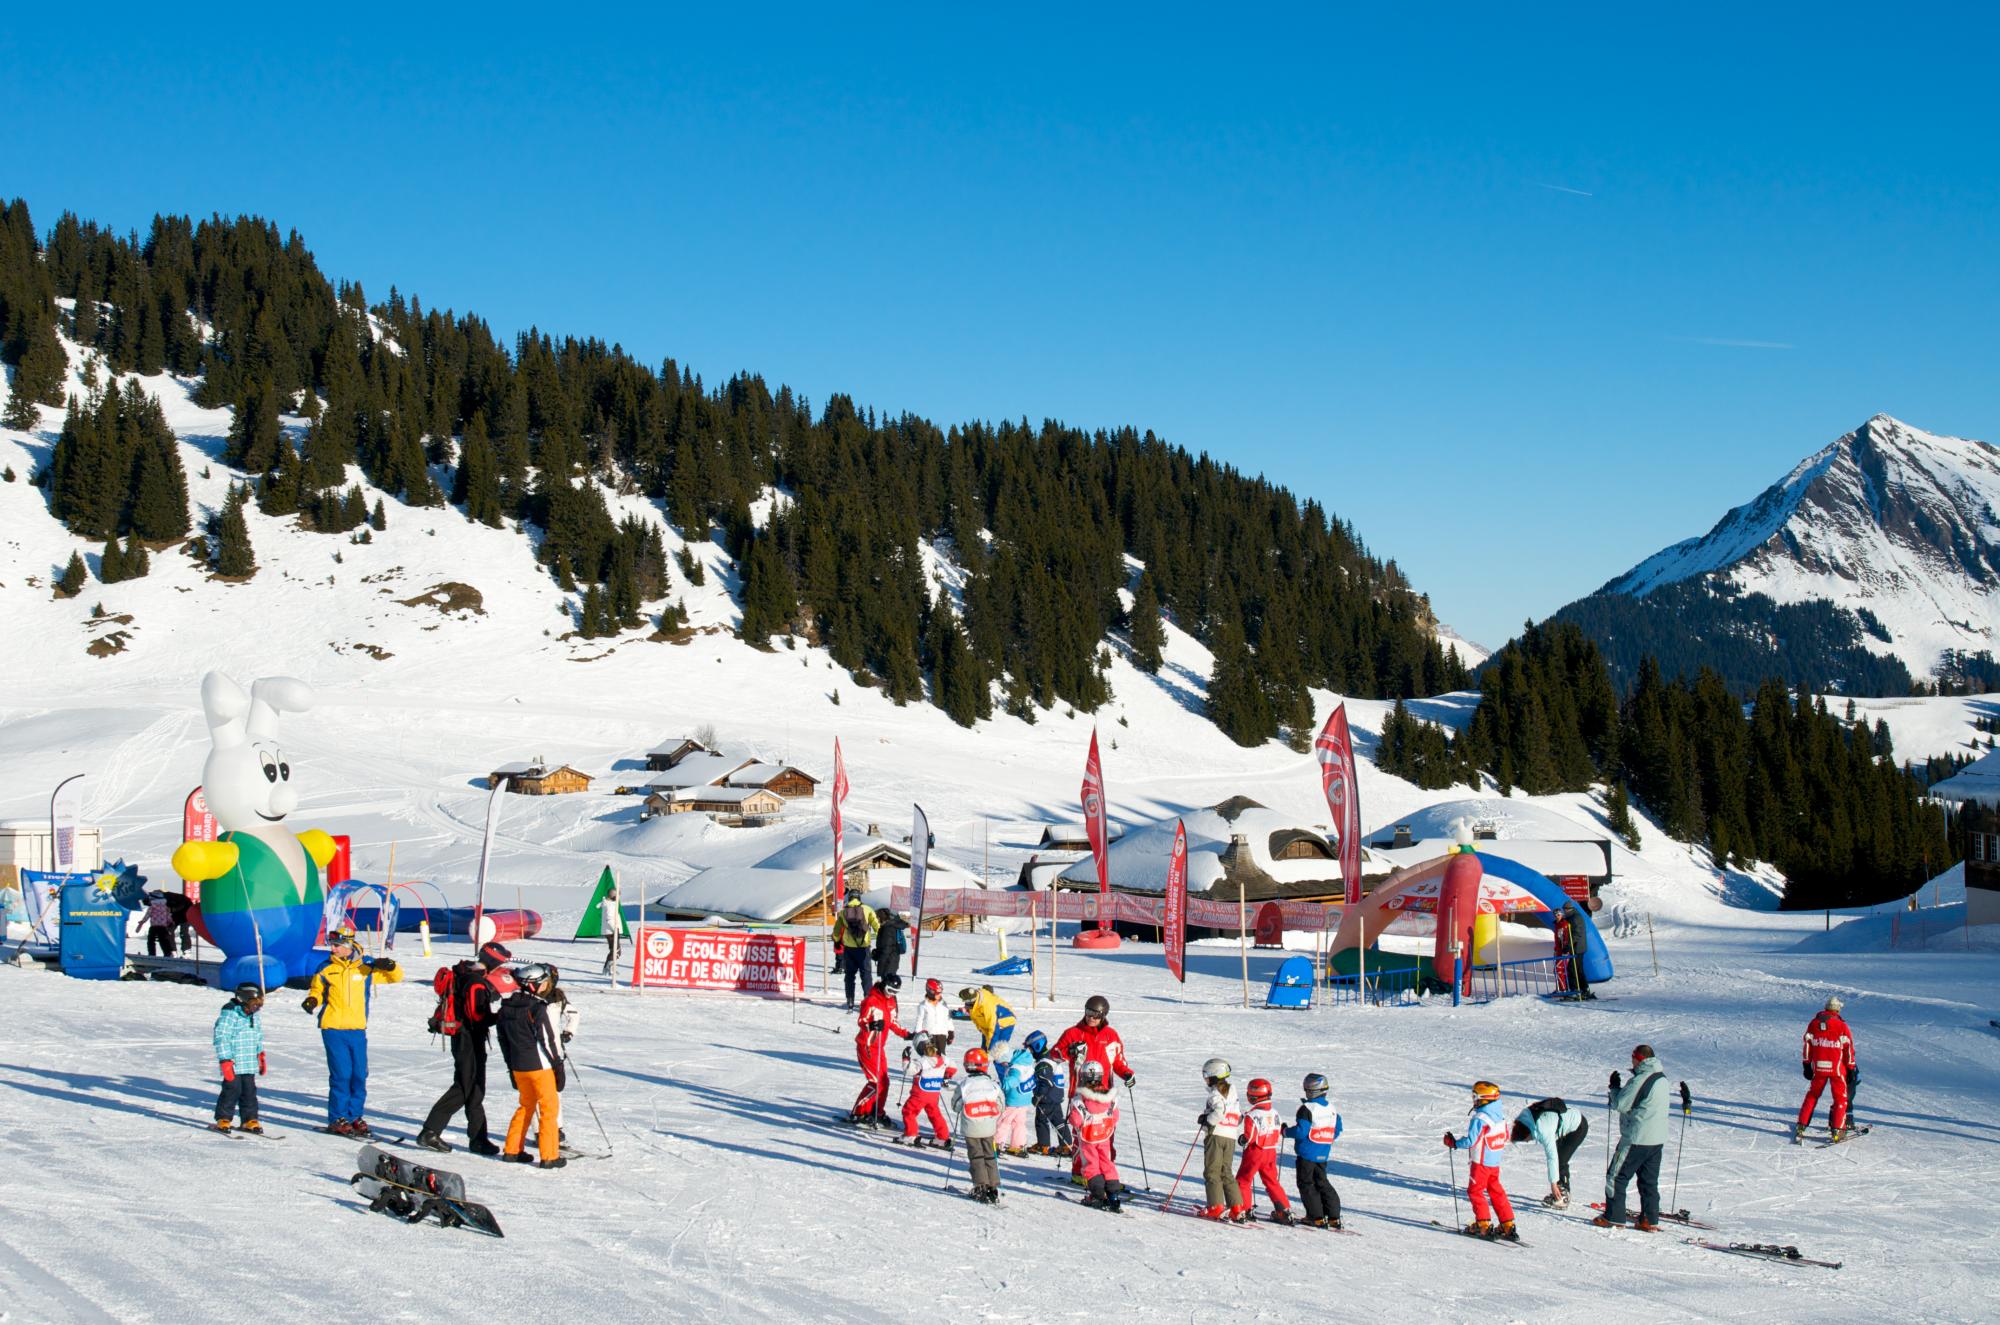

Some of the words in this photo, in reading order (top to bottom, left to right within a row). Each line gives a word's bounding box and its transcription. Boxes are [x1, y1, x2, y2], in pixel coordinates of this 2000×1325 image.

[682, 941, 726, 960] ECOLE
[728, 943, 776, 963] SUISSE
[778, 947, 794, 964] DE
[644, 958, 668, 976] SKI
[670, 959, 689, 978] ET
[691, 961, 710, 979] DE
[711, 962, 794, 984] SNOWBOARD
